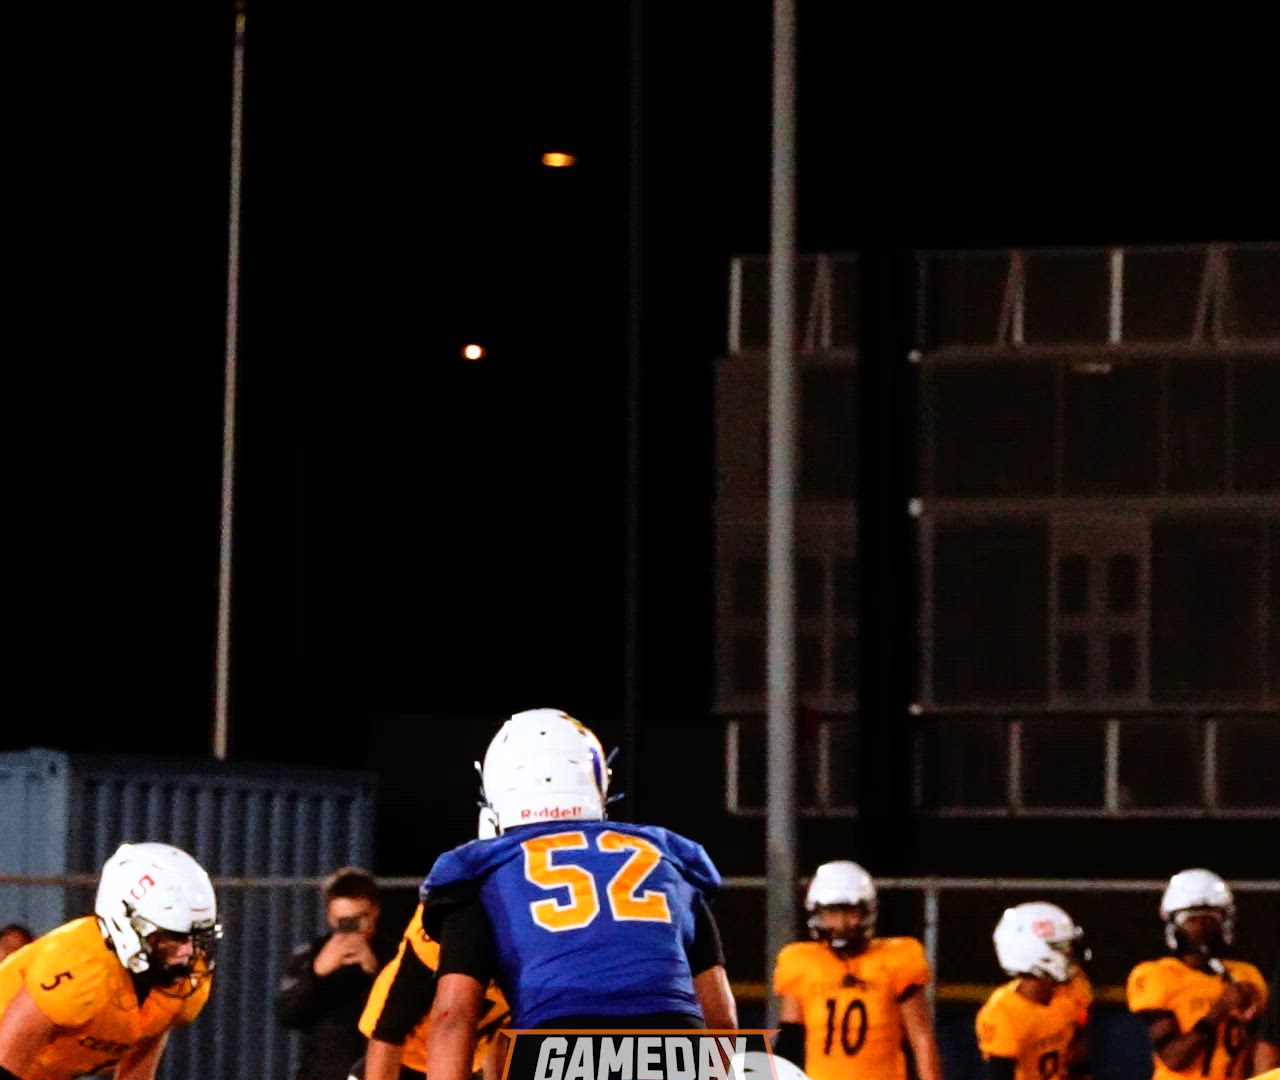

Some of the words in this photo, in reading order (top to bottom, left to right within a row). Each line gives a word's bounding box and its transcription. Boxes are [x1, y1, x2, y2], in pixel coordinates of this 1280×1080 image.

[130, 873, 156, 901] 5
[520, 831, 672, 932] 52
[39, 970, 73, 990] 5
[823, 998, 868, 1057] 10
